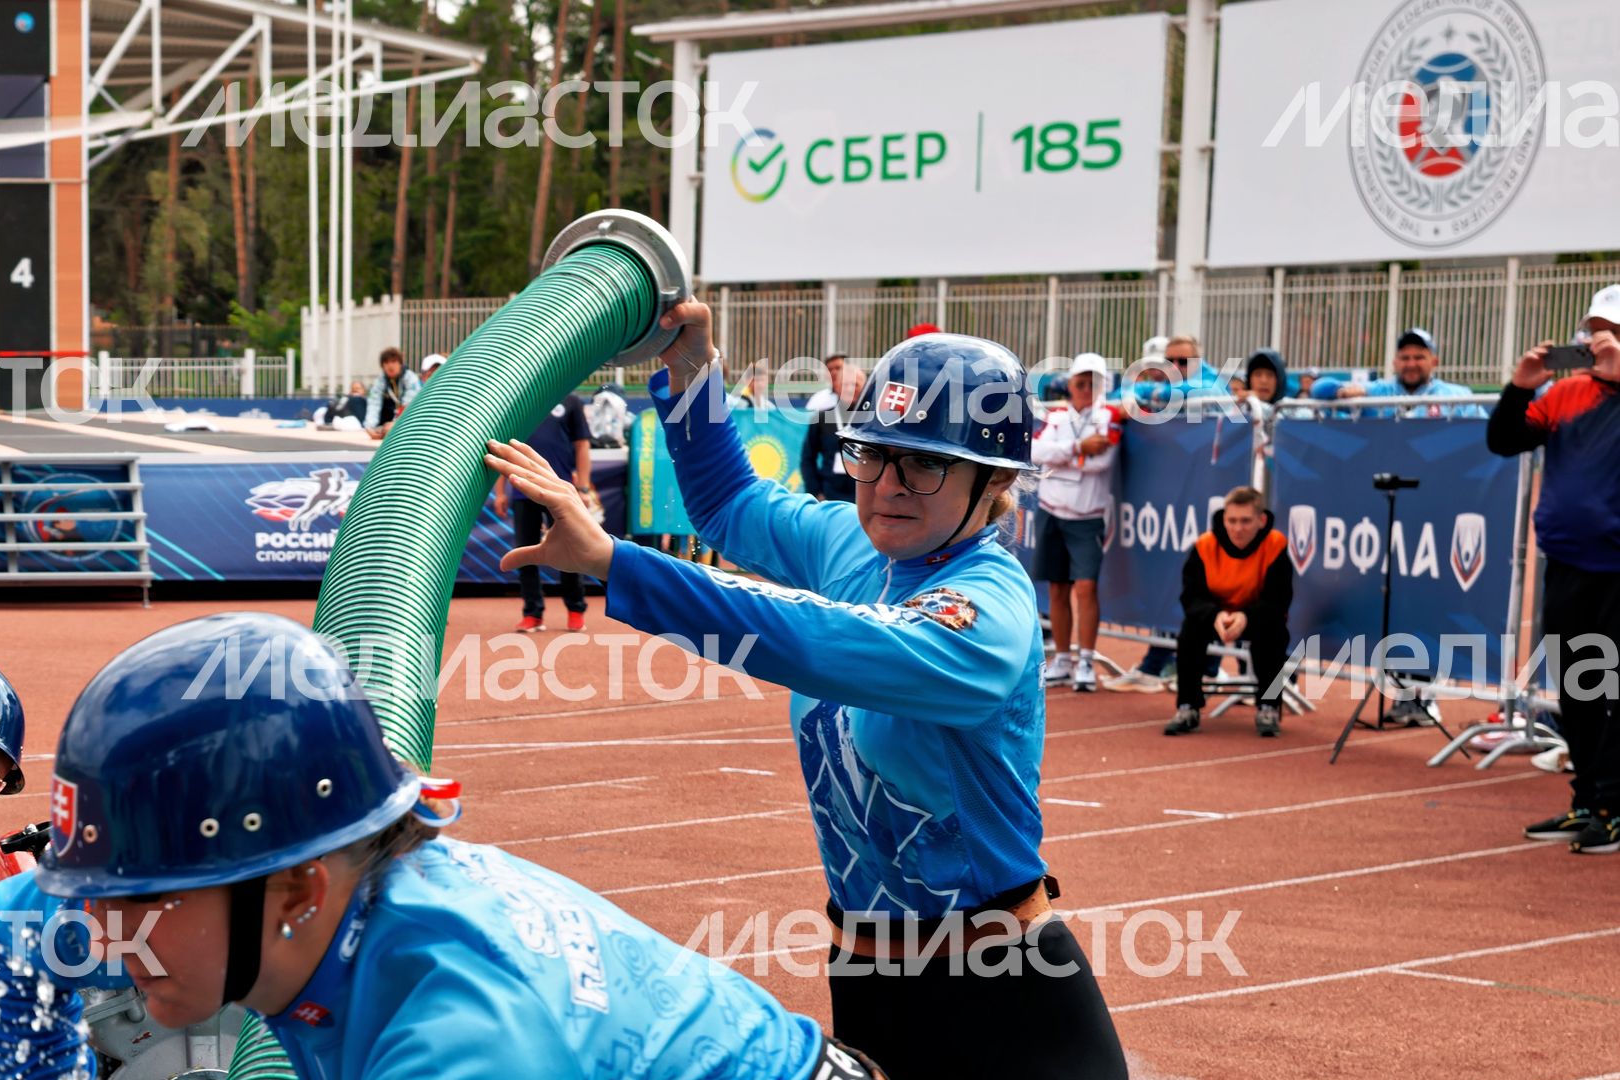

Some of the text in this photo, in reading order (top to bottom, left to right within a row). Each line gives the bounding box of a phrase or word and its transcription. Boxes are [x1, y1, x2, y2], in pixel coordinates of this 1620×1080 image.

[804, 117, 1123, 186] СБЕР 185
[9, 257, 35, 289] 4
[1119, 500, 1198, 553] ВФЛА
[1322, 515, 1442, 580] ВФЛА
